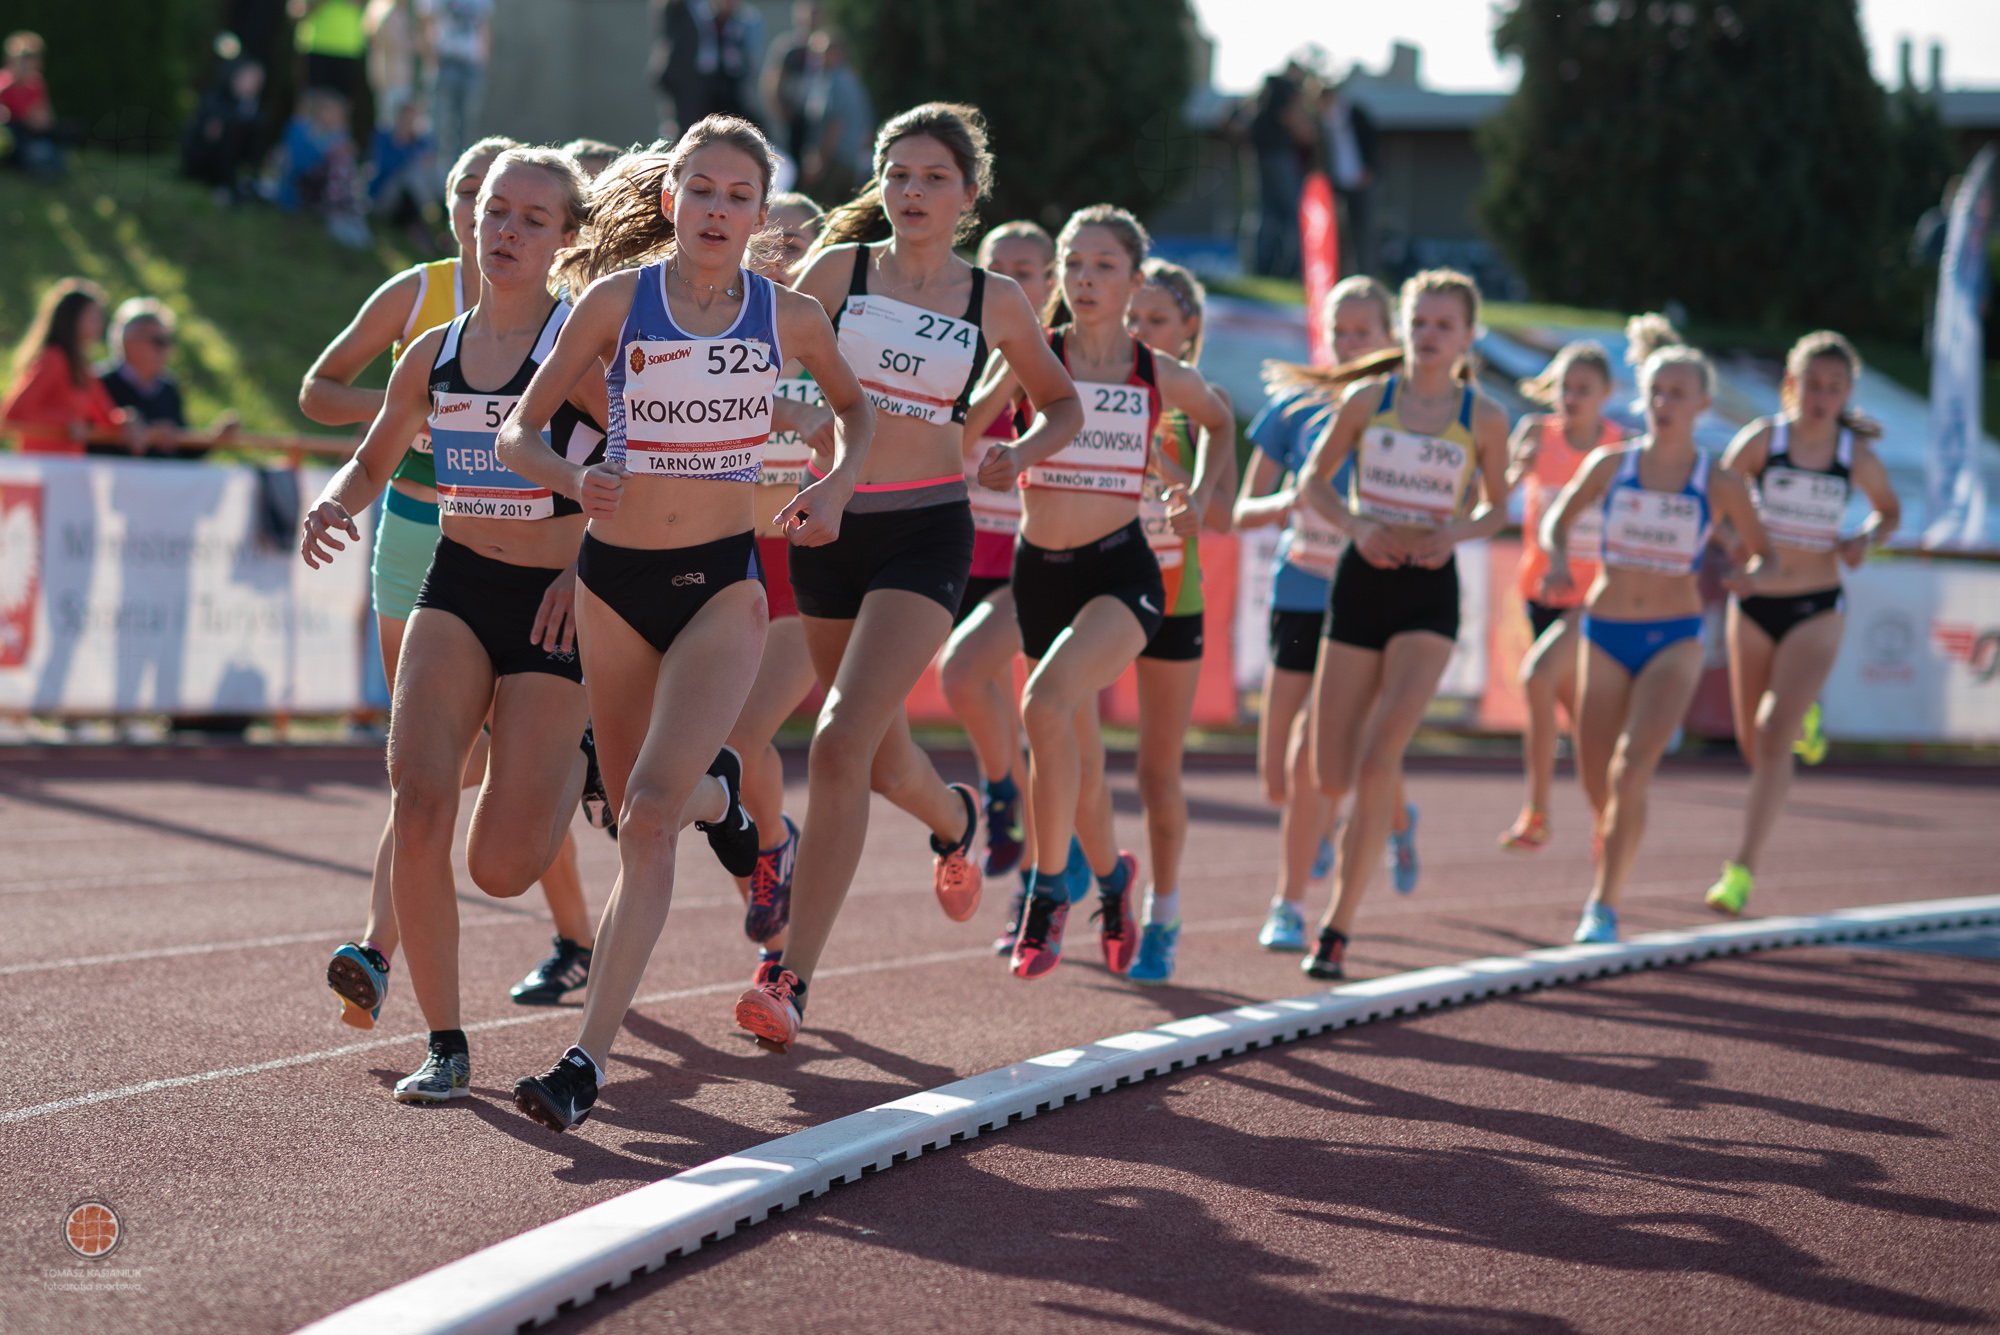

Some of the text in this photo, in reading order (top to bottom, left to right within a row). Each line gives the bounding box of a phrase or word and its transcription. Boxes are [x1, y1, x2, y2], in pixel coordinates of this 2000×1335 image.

[915, 314, 971, 349] 274
[707, 344, 771, 375] 523
[879, 349, 926, 376] SOT
[630, 395, 769, 424] KOKOSZKA
[864, 392, 903, 414] NÓW
[1094, 388, 1142, 415] 223
[1067, 430, 1143, 453] RKOWSKA
[1418, 440, 1462, 468] 390
[446, 448, 513, 475] RĘBIS
[649, 452, 752, 471] TARNÓW 2019
[1042, 472, 1126, 489] TARNÓW 2019
[444, 499, 532, 516] TARNÓW 2019
[671, 571, 706, 587] esa
